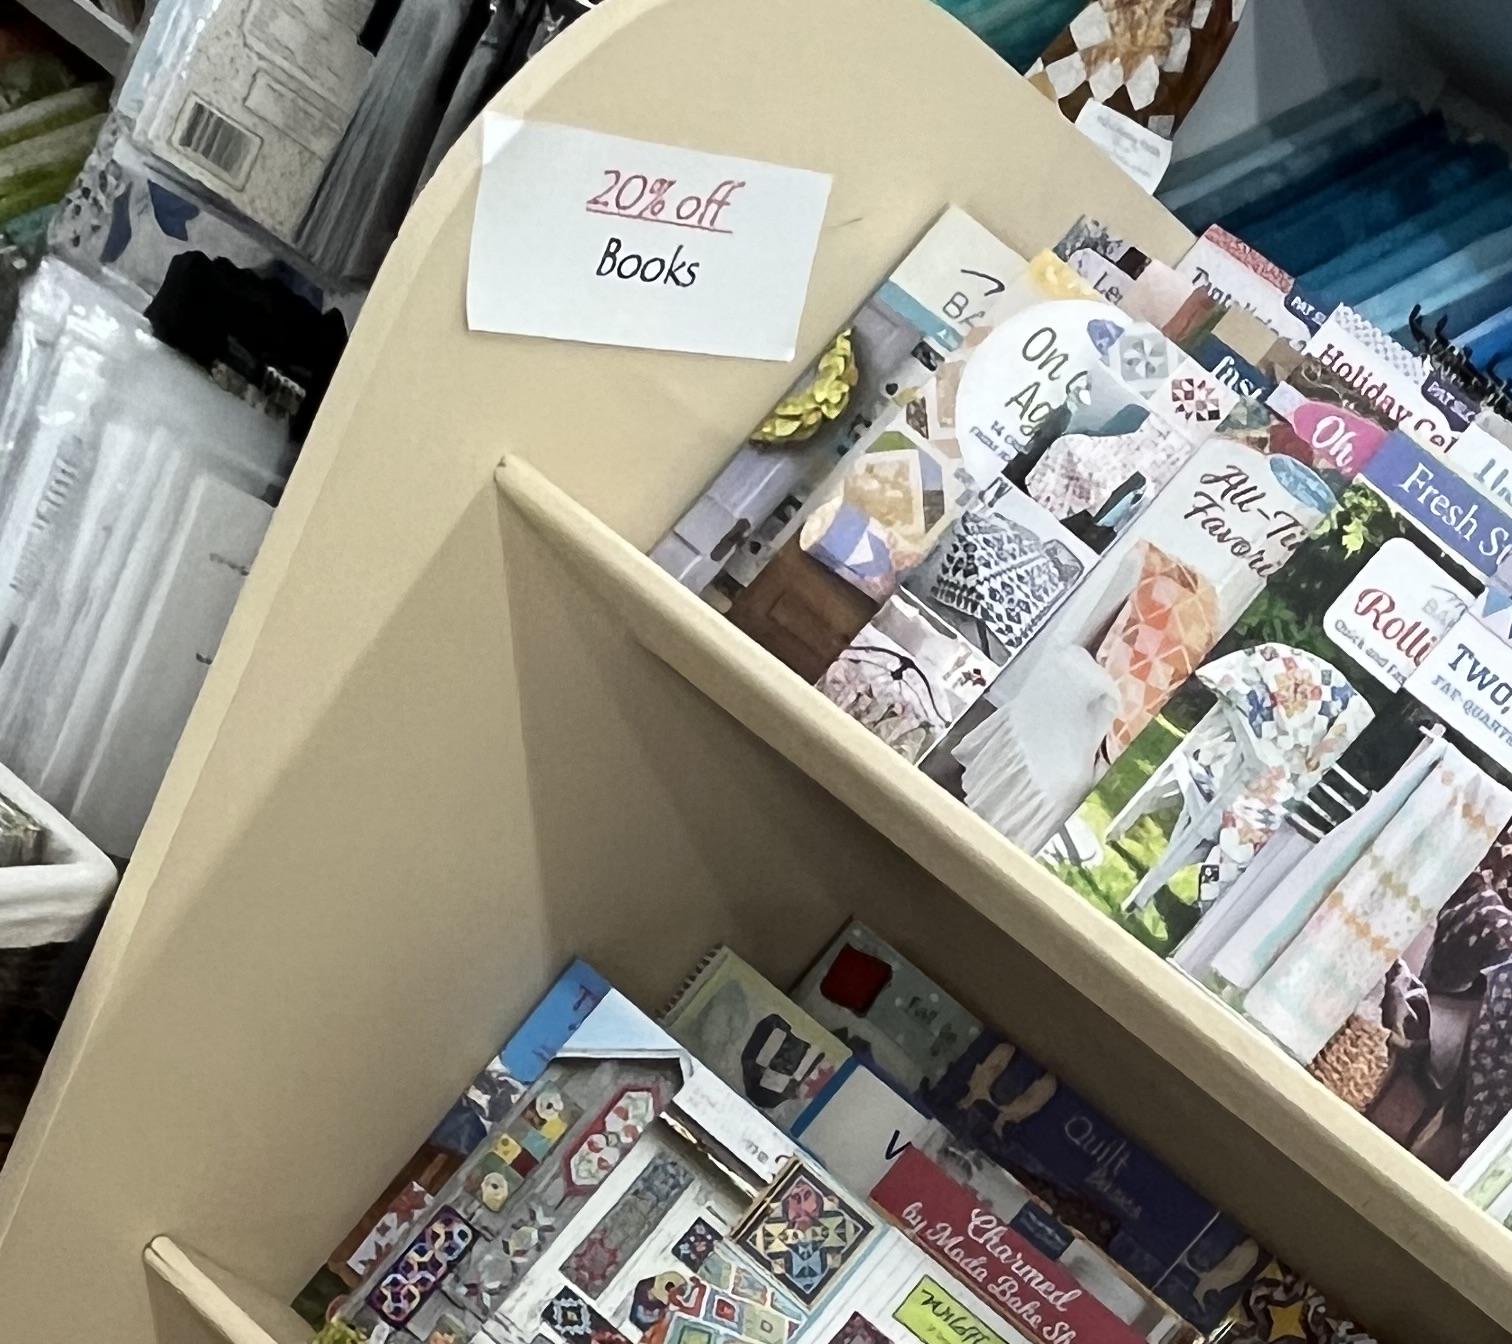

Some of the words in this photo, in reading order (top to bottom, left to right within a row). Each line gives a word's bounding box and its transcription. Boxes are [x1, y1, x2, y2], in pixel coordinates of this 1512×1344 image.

[587, 170, 676, 217] 20%
[676, 180, 746, 226] off
[596, 237, 699, 288] Books
[1319, 343, 1412, 425] Holiday
[1398, 462, 1480, 548] Fresh
[1448, 643, 1512, 715] TWO,
[903, 1202, 927, 1235] by
[926, 1222, 986, 1282] Moda
[987, 1276, 1041, 1329] Bake
[967, 1208, 1083, 1312] Charmed
